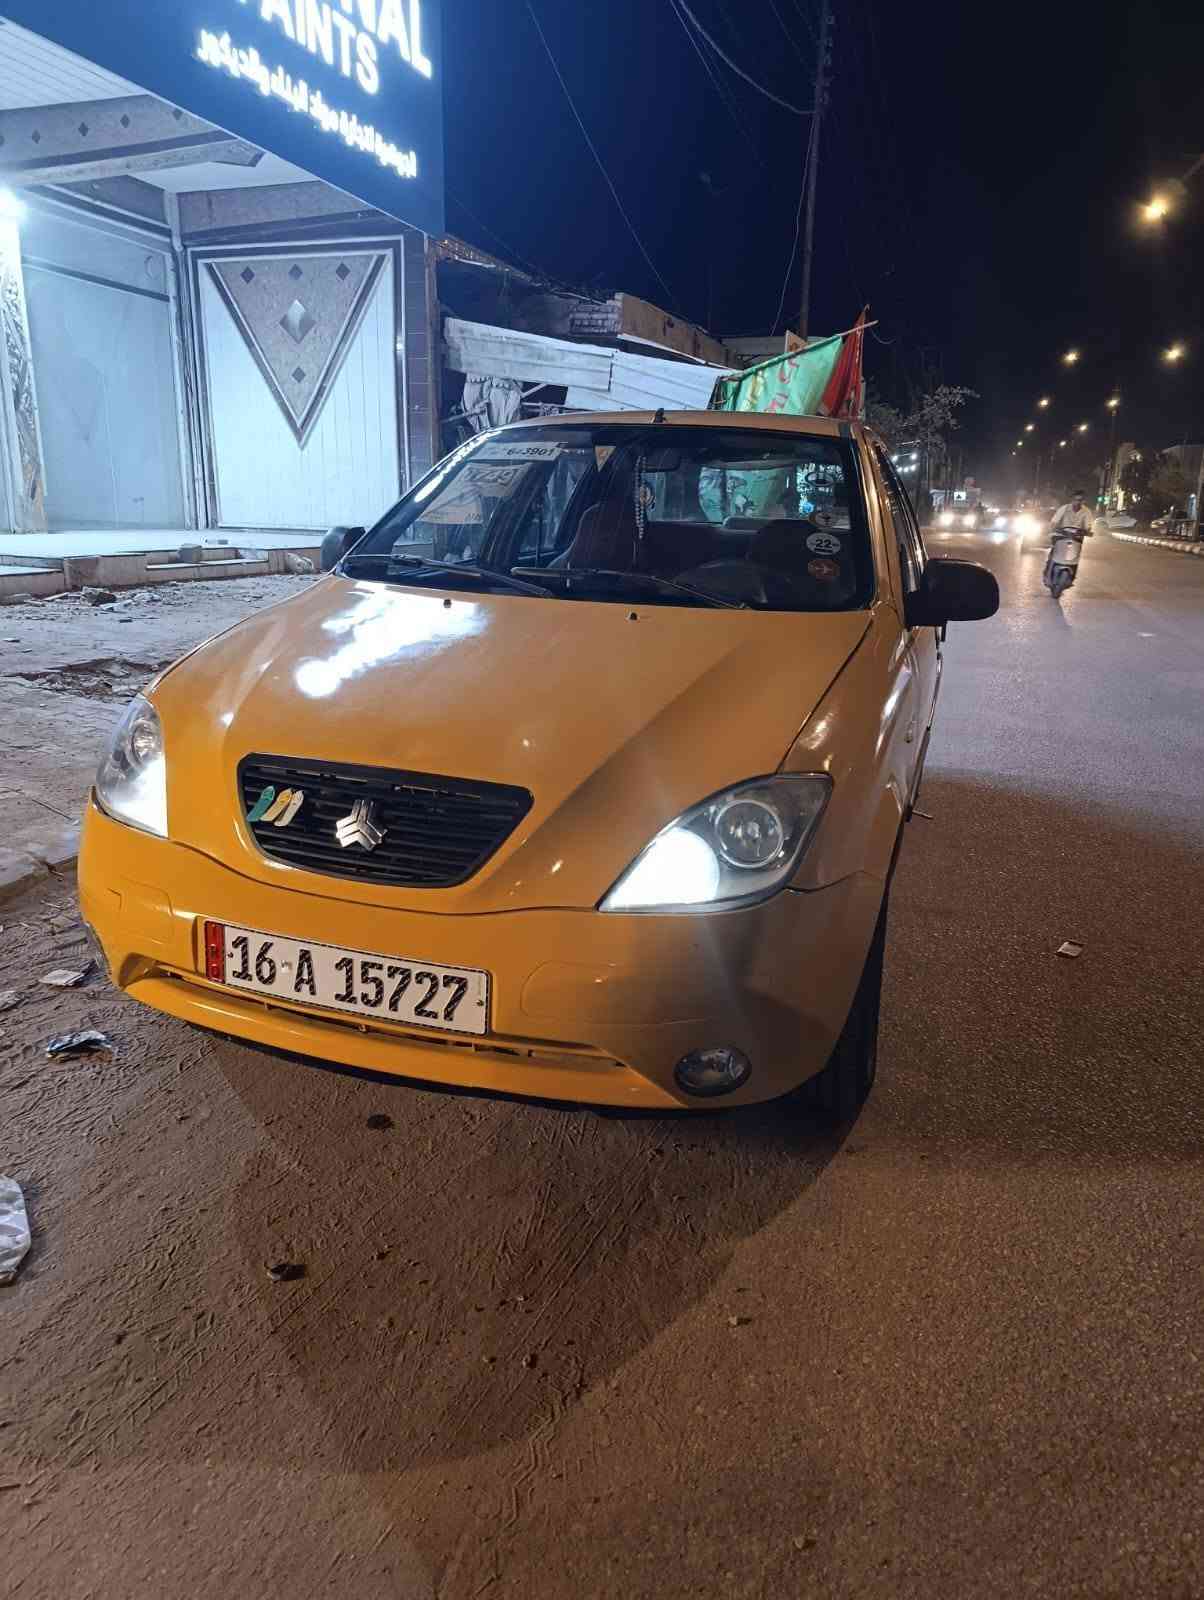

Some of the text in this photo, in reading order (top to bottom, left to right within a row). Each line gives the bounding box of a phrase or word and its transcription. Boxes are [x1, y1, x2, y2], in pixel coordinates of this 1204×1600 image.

[816, 538, 832, 548] 22
[231, 936, 277, 986] 16
[293, 949, 317, 996] A
[334, 956, 469, 1022] 15727
